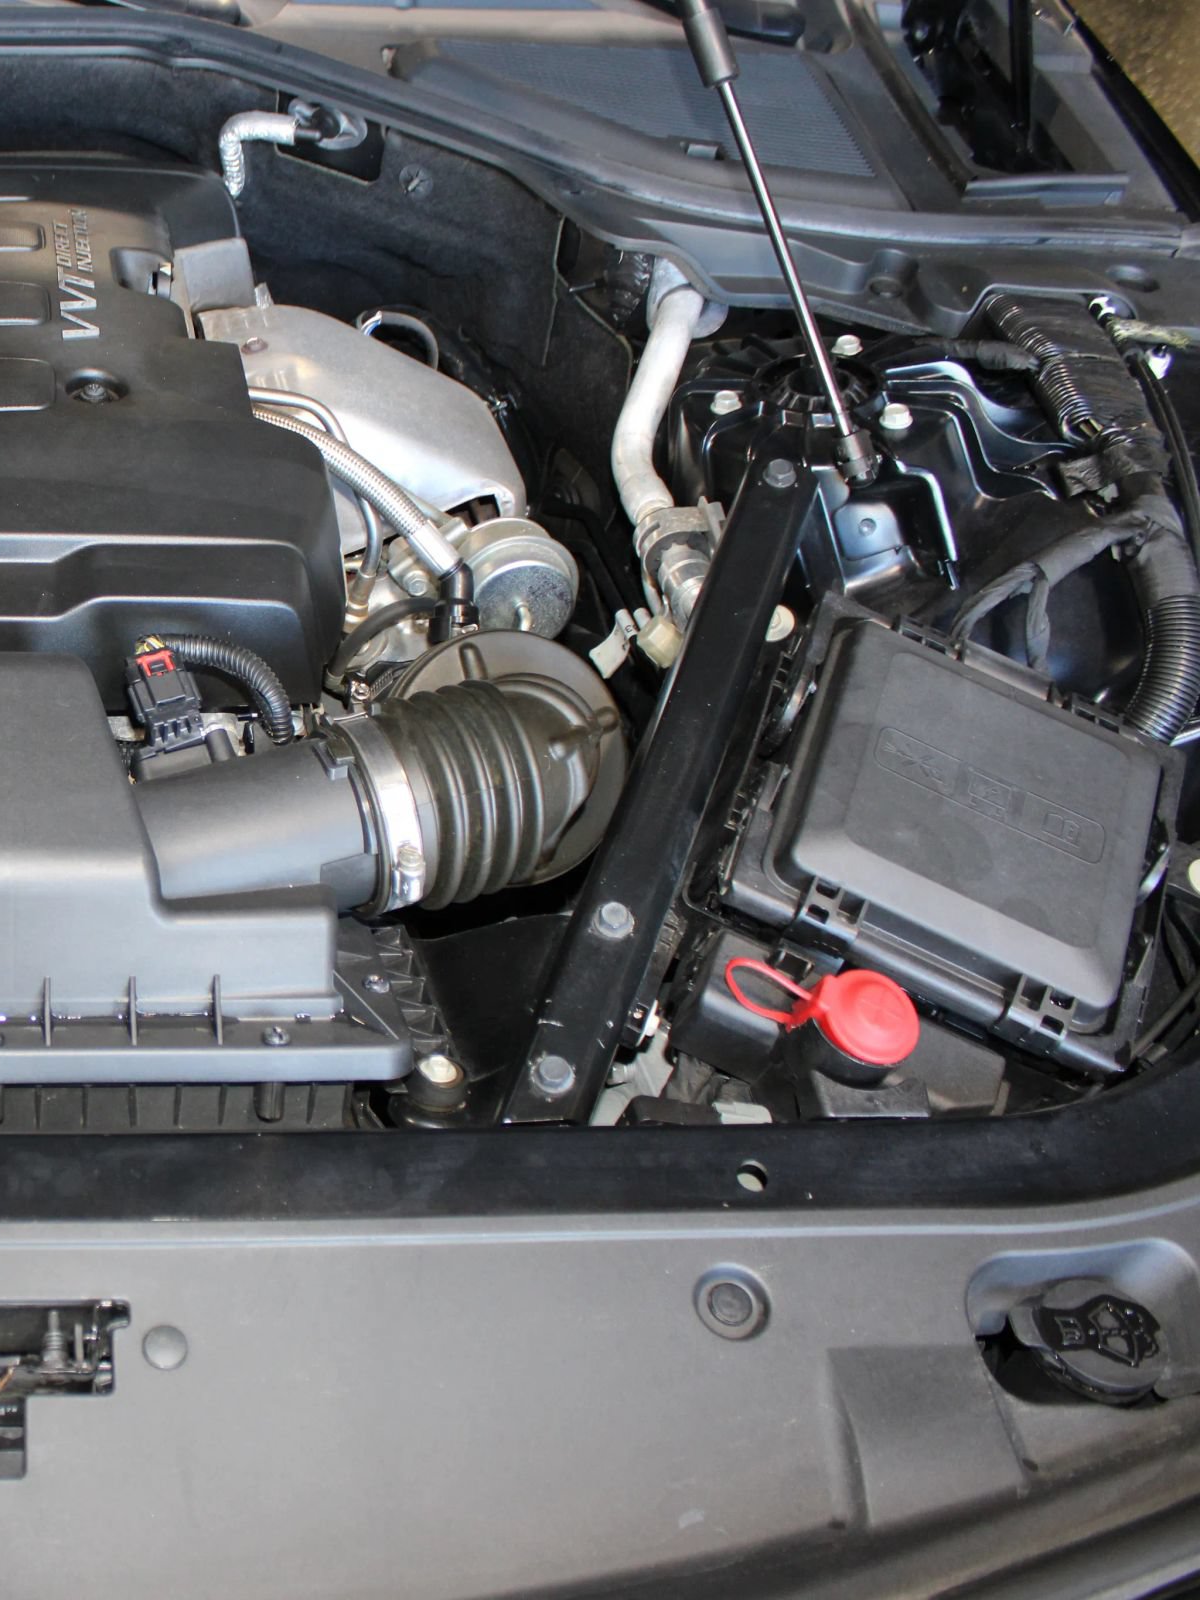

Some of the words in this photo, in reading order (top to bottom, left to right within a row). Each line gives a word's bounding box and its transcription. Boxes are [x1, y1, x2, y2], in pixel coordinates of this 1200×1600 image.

[54, 221, 72, 268] DIRECT
[70, 208, 93, 271] INJECTION
[58, 265, 100, 340] VVT
